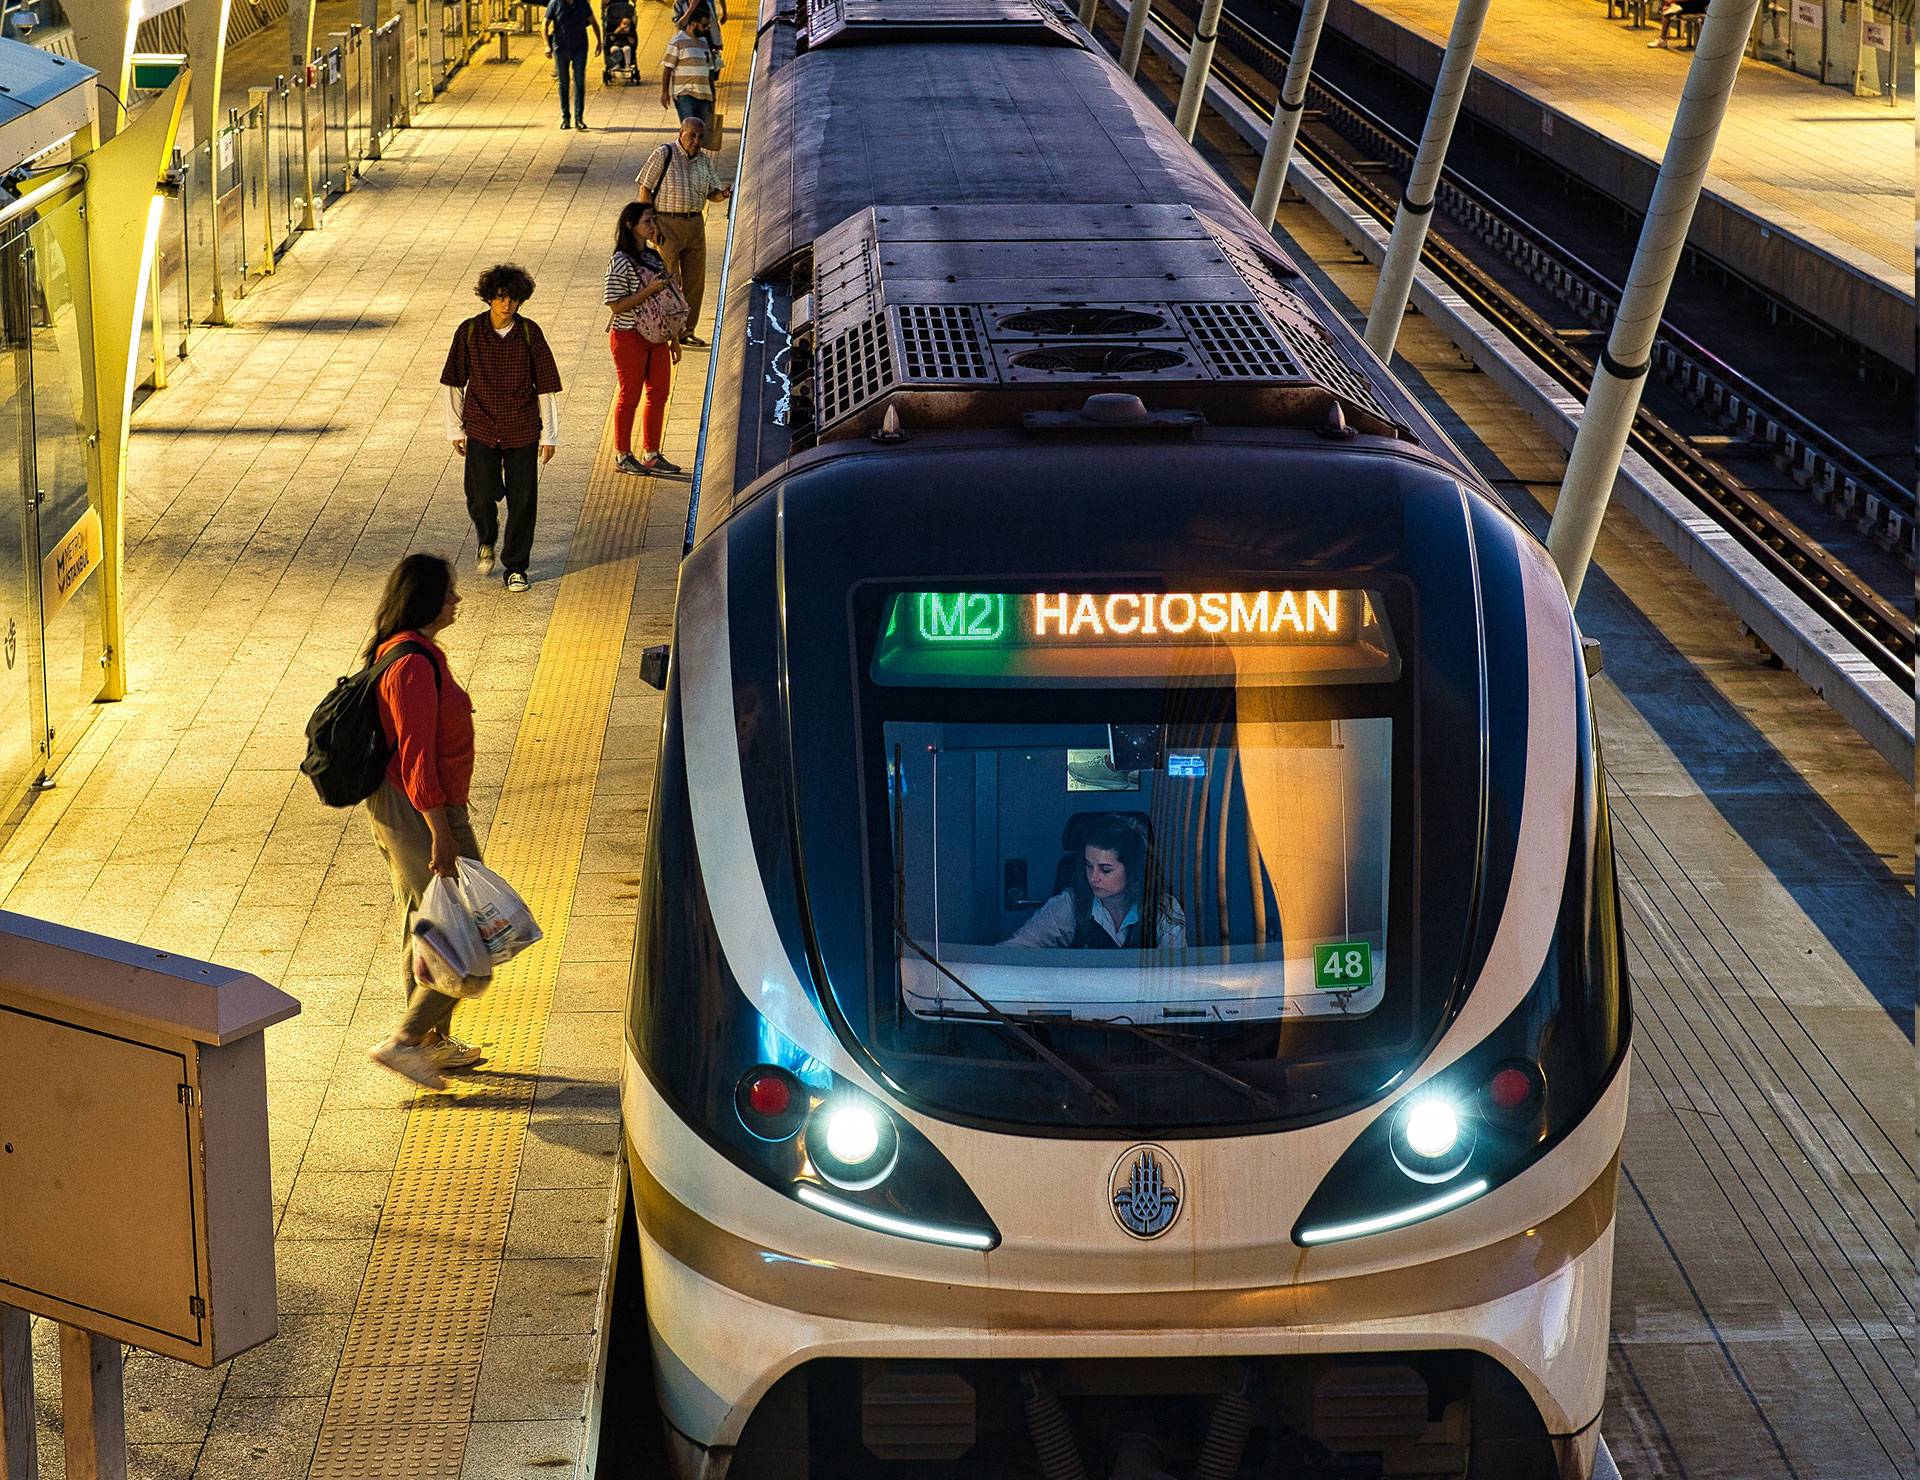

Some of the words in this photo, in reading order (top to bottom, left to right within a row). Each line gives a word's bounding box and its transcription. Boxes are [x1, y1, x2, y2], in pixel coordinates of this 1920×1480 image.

[932, 592, 992, 635] M2
[1035, 590, 1338, 635] HACIOSMAN
[1323, 950, 1363, 979] 48
